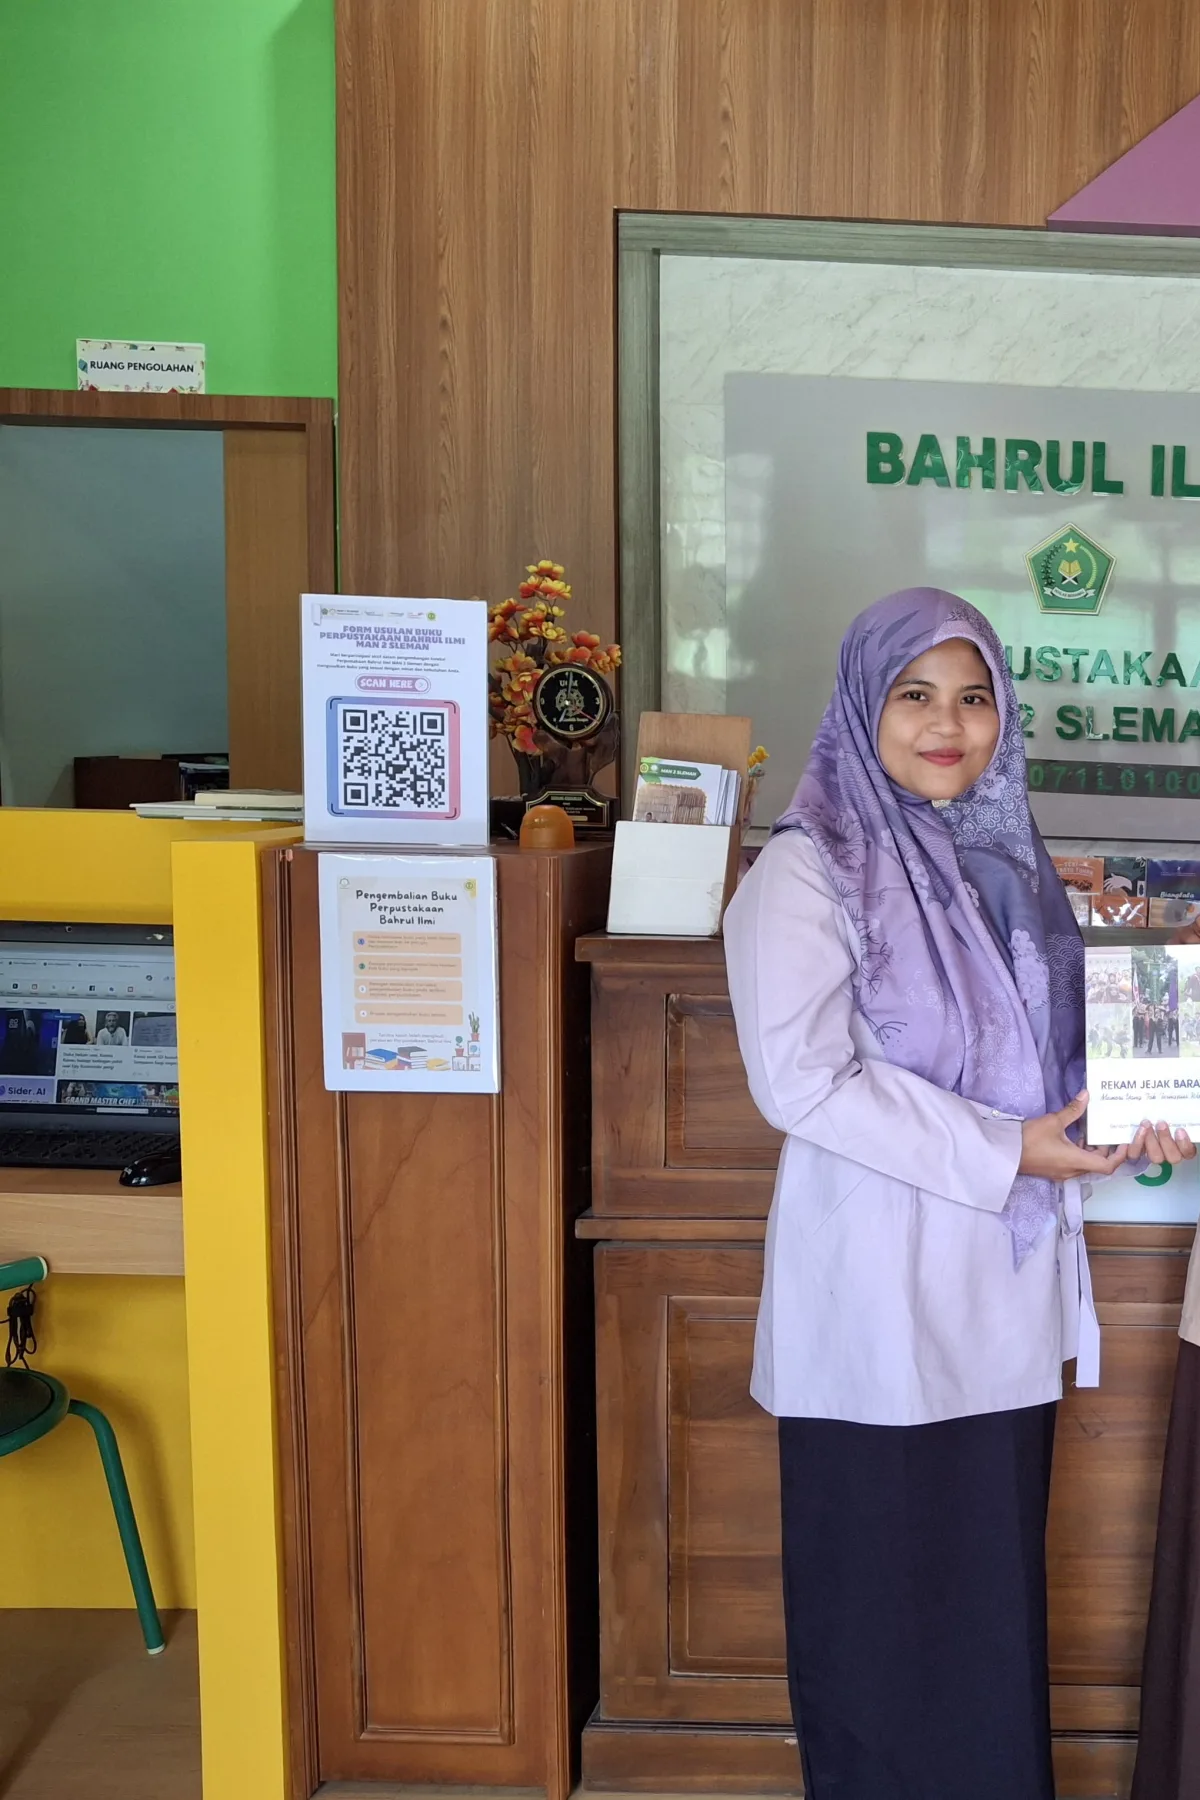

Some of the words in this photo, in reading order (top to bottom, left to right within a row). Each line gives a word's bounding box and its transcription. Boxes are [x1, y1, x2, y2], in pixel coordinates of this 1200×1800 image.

[90, 360, 125, 370] RUANG
[127, 362, 194, 373] PENGOLAHAN
[866, 431, 1124, 495] BAHRUL
[343, 625, 372, 633] FORM
[373, 626, 413, 635] USULAN
[415, 628, 443, 637] BUKU
[319, 632, 401, 643] PERPUSTAKAAN
[403, 635, 443, 644] BAHRUL
[444, 637, 466, 645] ILMI
[355, 640, 379, 649] MAN
[381, 641, 387, 649] 2
[388, 641, 430, 651] SLEMAN
[360, 678, 387, 688] SCAN
[389, 679, 413, 689] HERE
[1018, 703, 1036, 738] 2
[355, 889, 428, 902] Pengembalian
[431, 891, 458, 901] Buku
[1160, 891, 1195, 899] Bianglala
[369, 902, 444, 915] Perpustakaan
[379, 915, 415, 925] Bahrul
[417, 916, 436, 926] Ilmi
[1100, 1080, 1137, 1090] REKAM
[1140, 1079, 1170, 1089] JEJAK
[65, 1096, 90, 1105] GRAND
[90, 1097, 118, 1105] MASTER
[118, 1097, 137, 1105] CHEF
